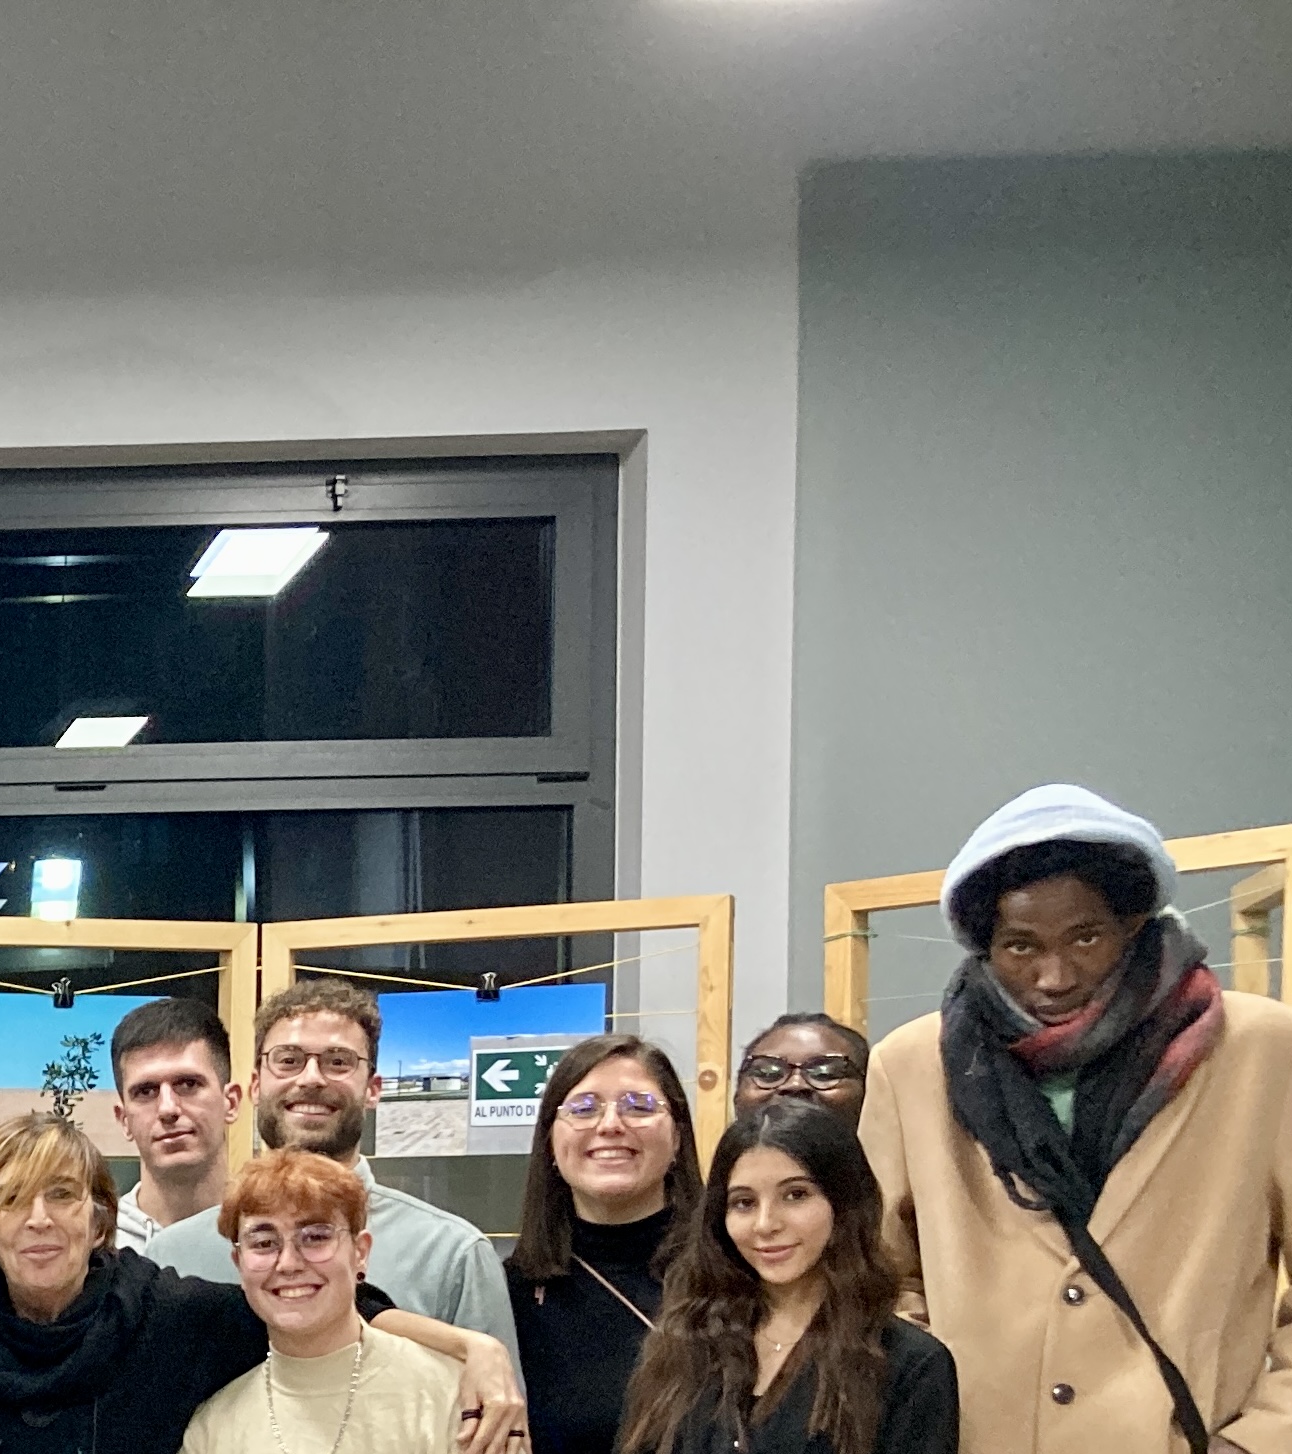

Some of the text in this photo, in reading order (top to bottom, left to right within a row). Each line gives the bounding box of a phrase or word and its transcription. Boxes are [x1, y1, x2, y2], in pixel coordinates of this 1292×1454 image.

[475, 1105, 536, 1117] AL PUNTO DI
